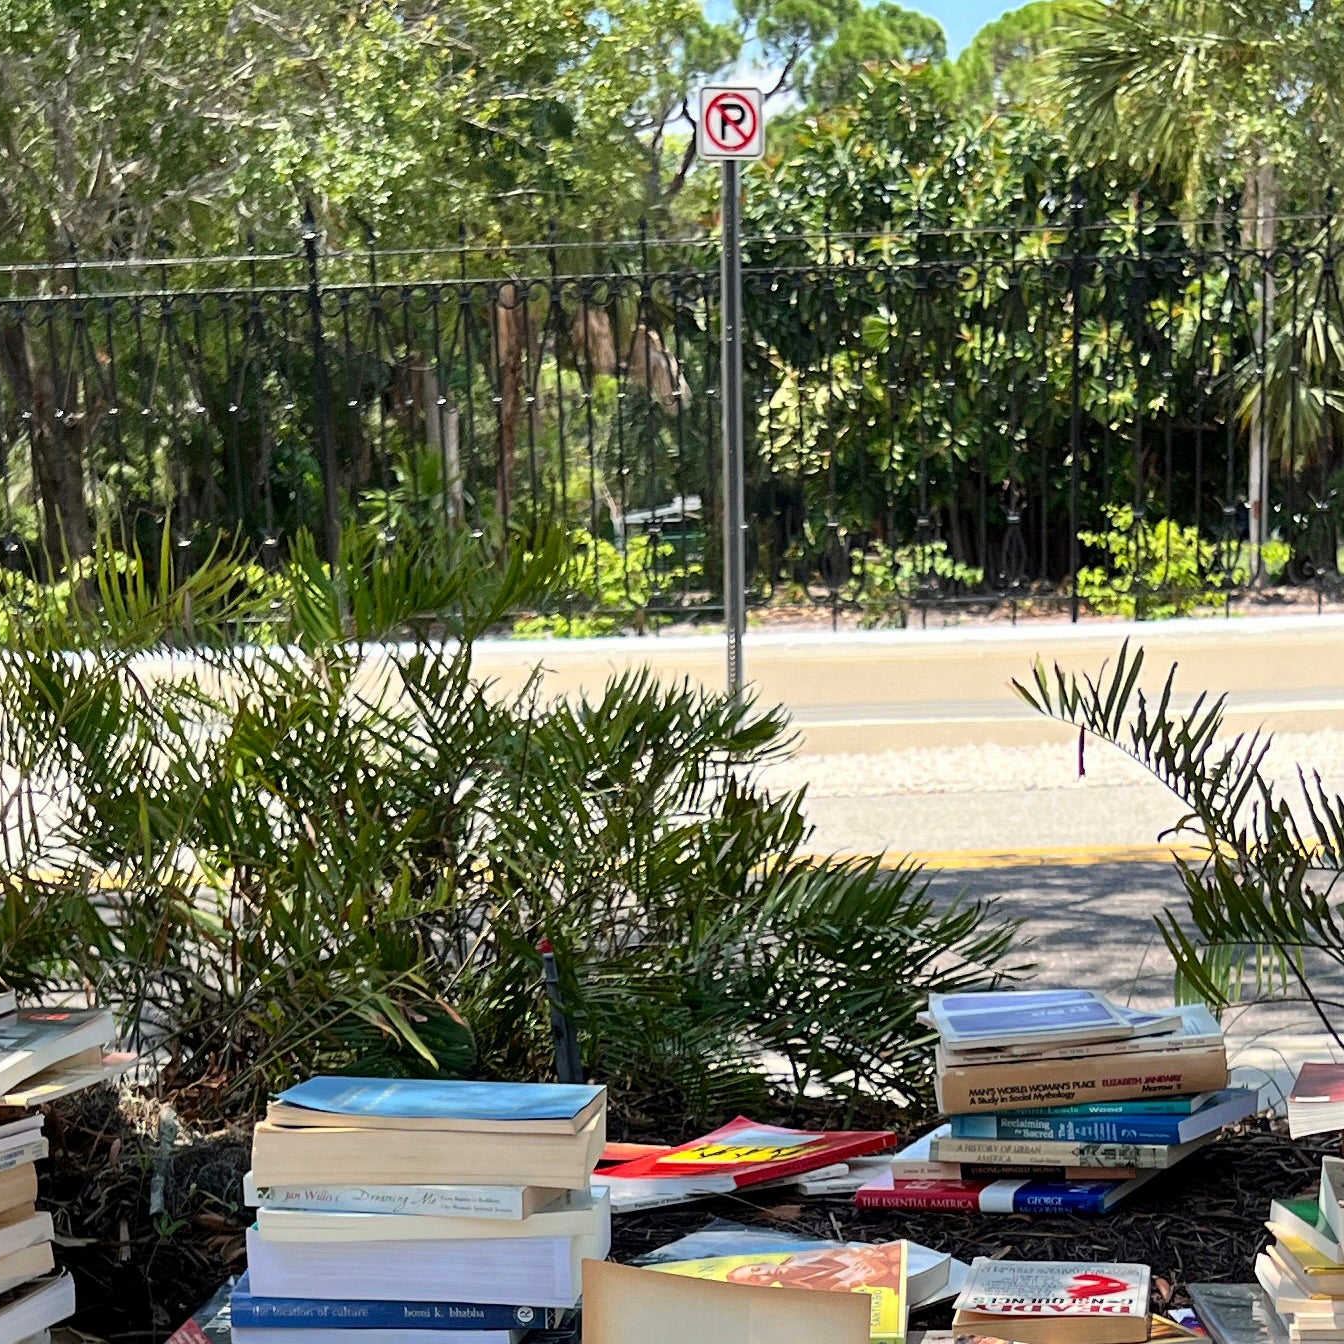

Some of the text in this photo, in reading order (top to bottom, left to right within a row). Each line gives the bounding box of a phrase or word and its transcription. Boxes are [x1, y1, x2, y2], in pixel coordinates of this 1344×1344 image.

[969, 1087, 996, 1097] MAN'S
[1072, 1079, 1096, 1090] PLACE
[1101, 1076, 1142, 1088] ELIZABETH
[1144, 1073, 1183, 1086] JANEWAY
[1032, 1091, 1076, 1104] Mythology
[1000, 1118, 1052, 1131] Reclaiming
[1023, 1127, 1055, 1140] Sacred
[964, 1144, 1042, 1155] HISTORY OF URBAN
[976, 1154, 1012, 1164] AMERICA
[285, 1188, 302, 1202] Jan
[353, 1187, 408, 1213] Dreaming
[862, 1195, 1063, 1210] THE ESSENTIAL AMERICA GEORGE
[252, 1305, 485, 1319] the location of culture homi bhabha
